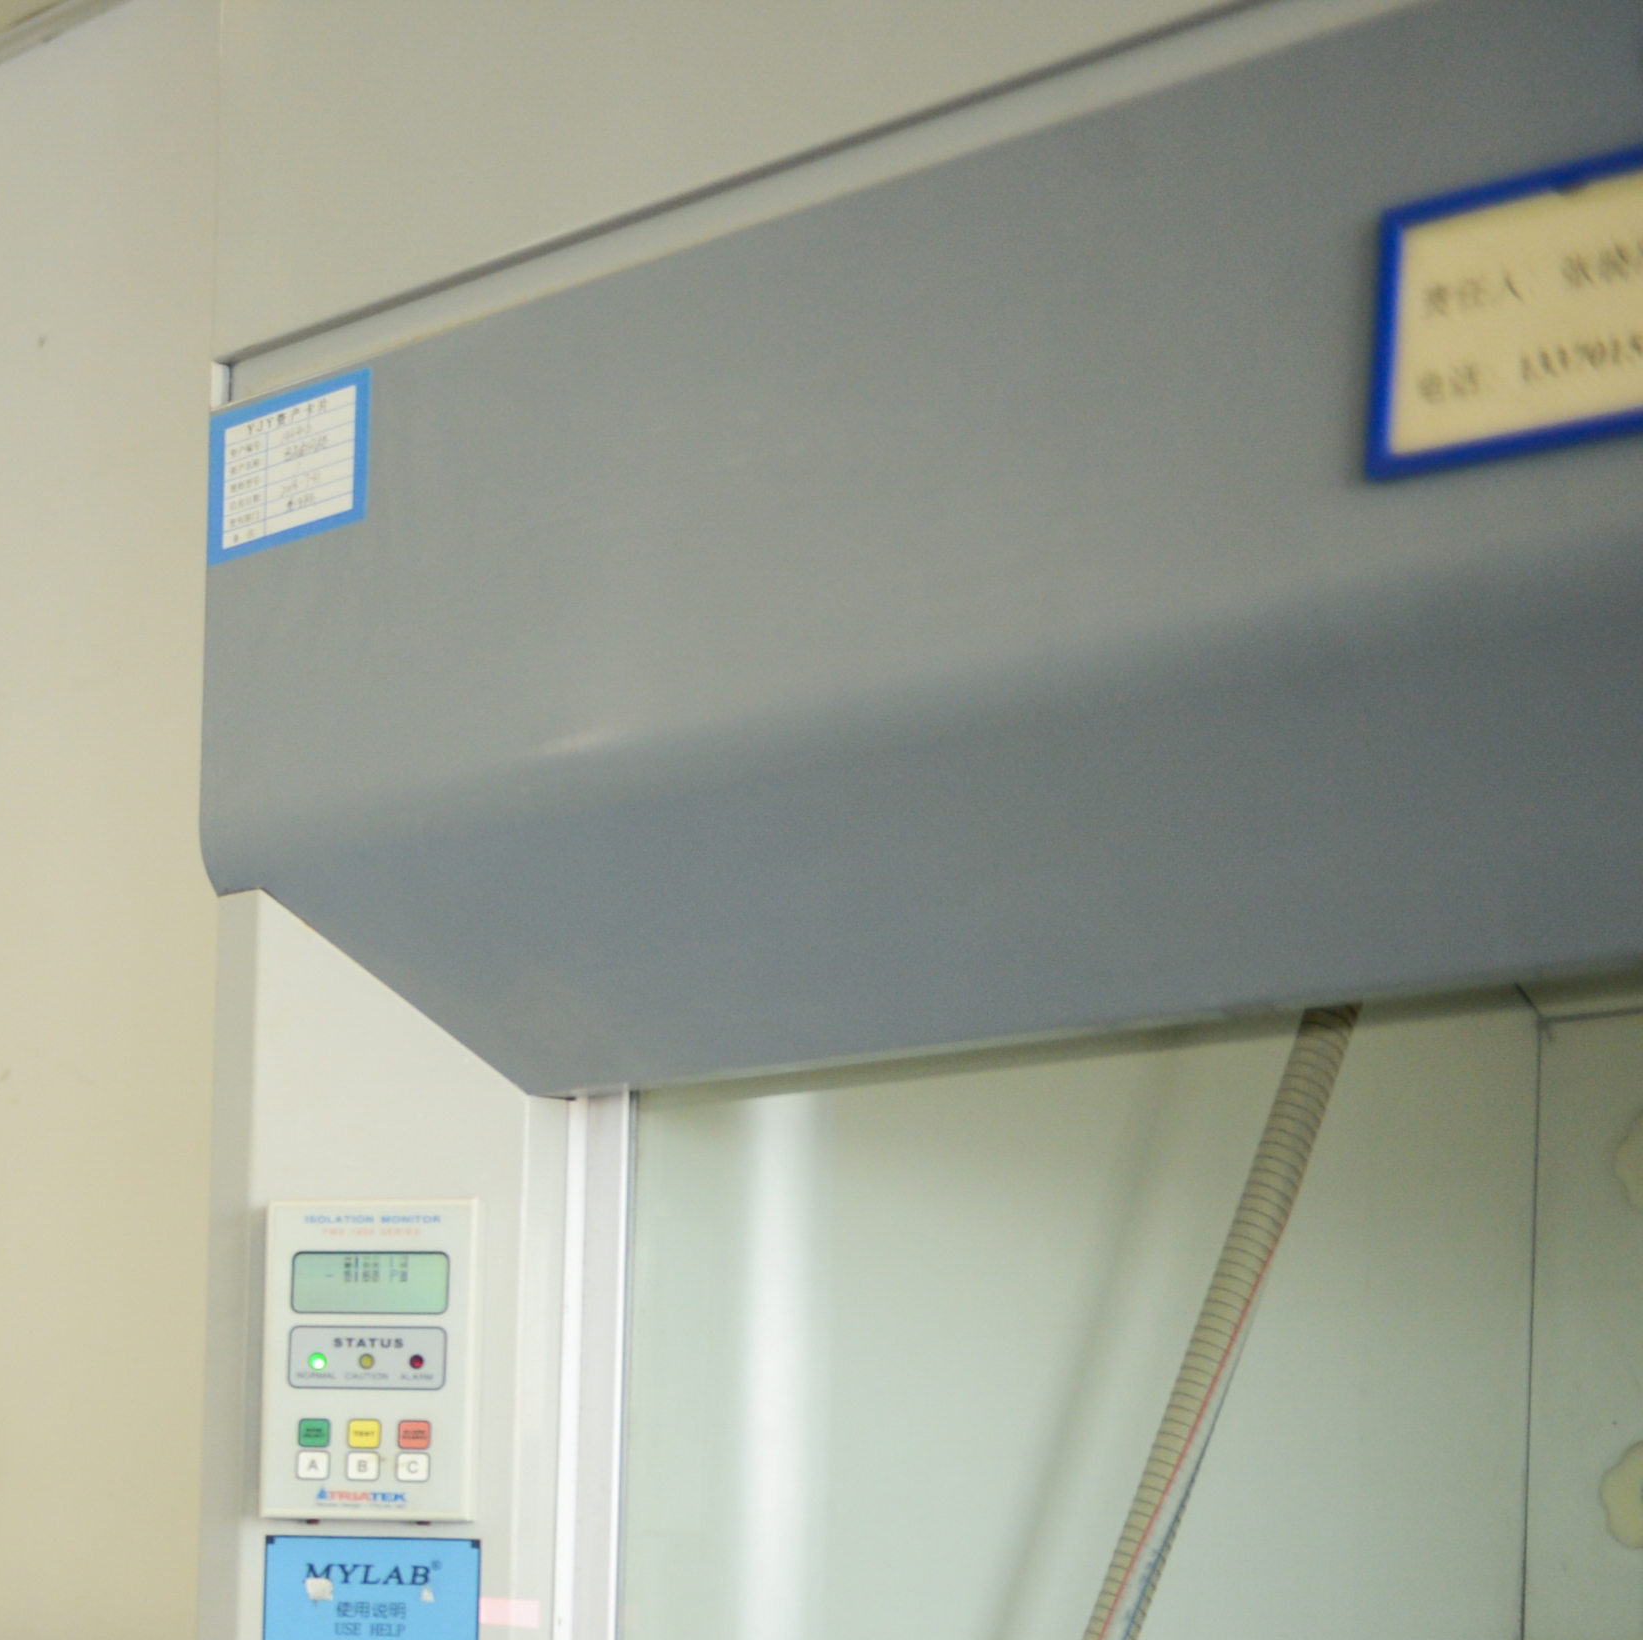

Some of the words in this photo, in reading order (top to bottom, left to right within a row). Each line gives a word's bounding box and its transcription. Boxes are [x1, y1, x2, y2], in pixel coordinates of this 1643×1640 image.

[304, 1215, 374, 1224] ISOLATION
[381, 1215, 441, 1224] MONITOR
[333, 1337, 404, 1349] STATUS
[308, 1459, 319, 1472] A
[358, 1460, 368, 1473] B
[407, 1460, 419, 1474] C
[328, 1490, 407, 1502] TRIATEK
[303, 1562, 431, 1586] MYLAB
[336, 1601, 406, 1619] 使用说明
[334, 1622, 362, 1637] USE
[370, 1622, 406, 1638] HELP
